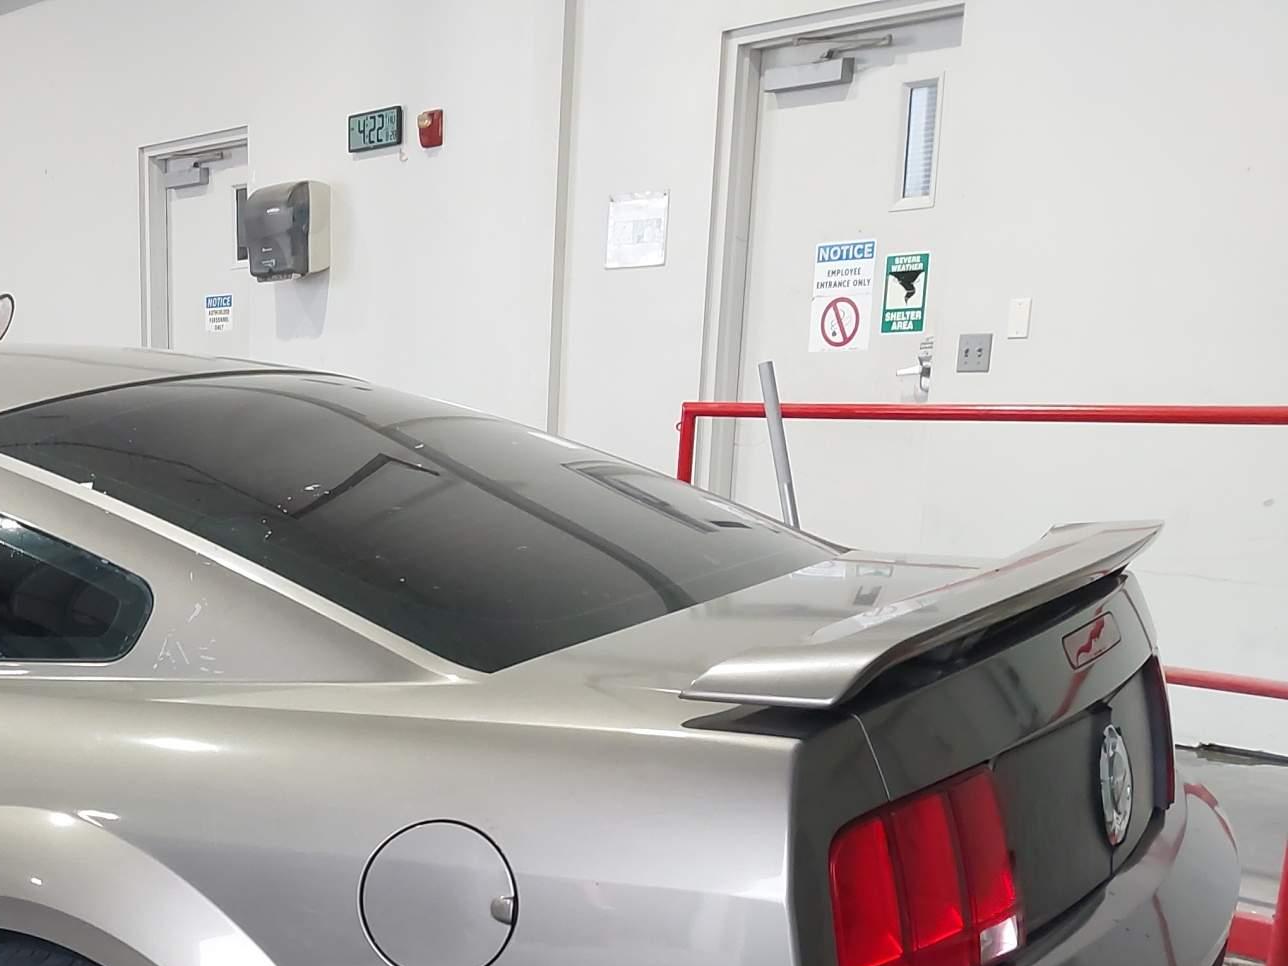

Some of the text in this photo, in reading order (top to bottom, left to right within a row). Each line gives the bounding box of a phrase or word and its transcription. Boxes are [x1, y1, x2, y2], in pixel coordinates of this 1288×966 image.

[357, 113, 385, 144] 4:22
[818, 243, 873, 261] NOTICE
[894, 255, 921, 265] SEVERE
[827, 267, 862, 278] EMPLOYEE
[891, 262, 924, 272] WEATHER
[816, 278, 871, 289] ENTRANCE ONLY
[207, 296, 231, 308] NOTICE
[885, 311, 922, 321] SHELTER
[891, 321, 914, 331] AREA
